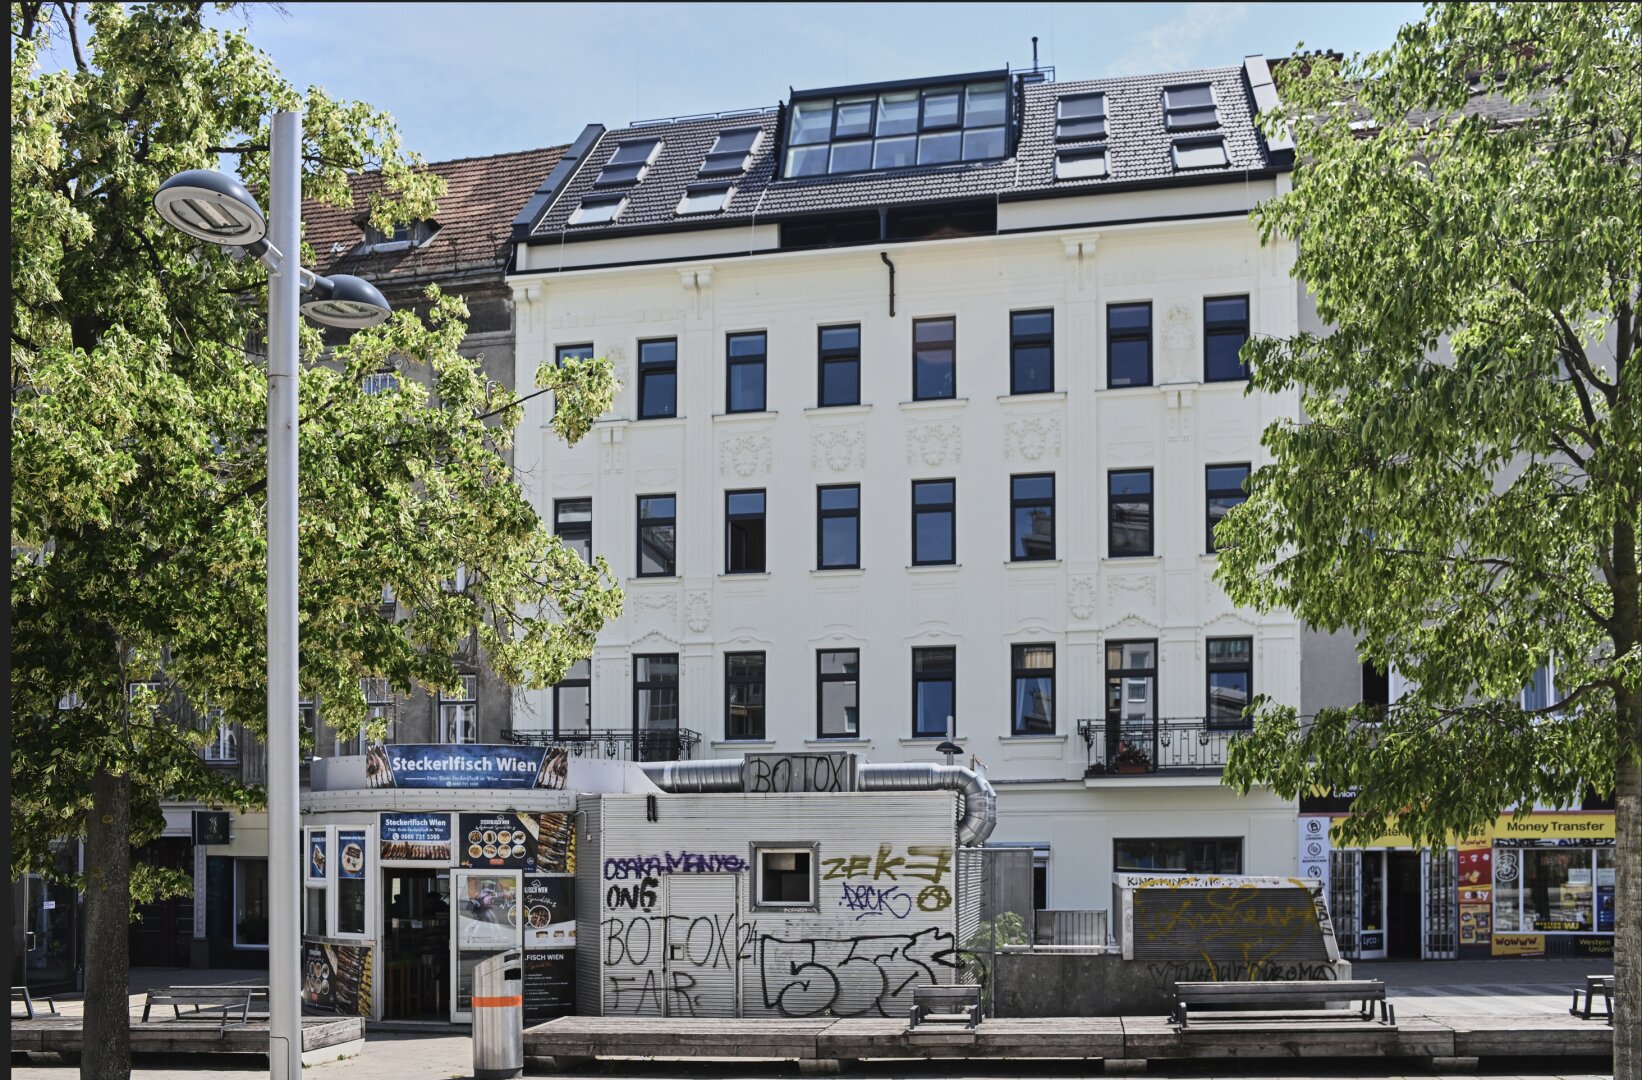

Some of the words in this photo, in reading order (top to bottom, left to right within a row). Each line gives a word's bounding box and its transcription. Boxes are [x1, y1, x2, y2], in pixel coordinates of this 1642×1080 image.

[392, 756, 492, 772] Steckerlfisch
[496, 757, 537, 772] Wien
[385, 818, 428, 826] Steckerlfisch
[1507, 821, 1549, 833] Money
[1551, 821, 1605, 831] Transfer
[601, 913, 735, 971] BOTOX
